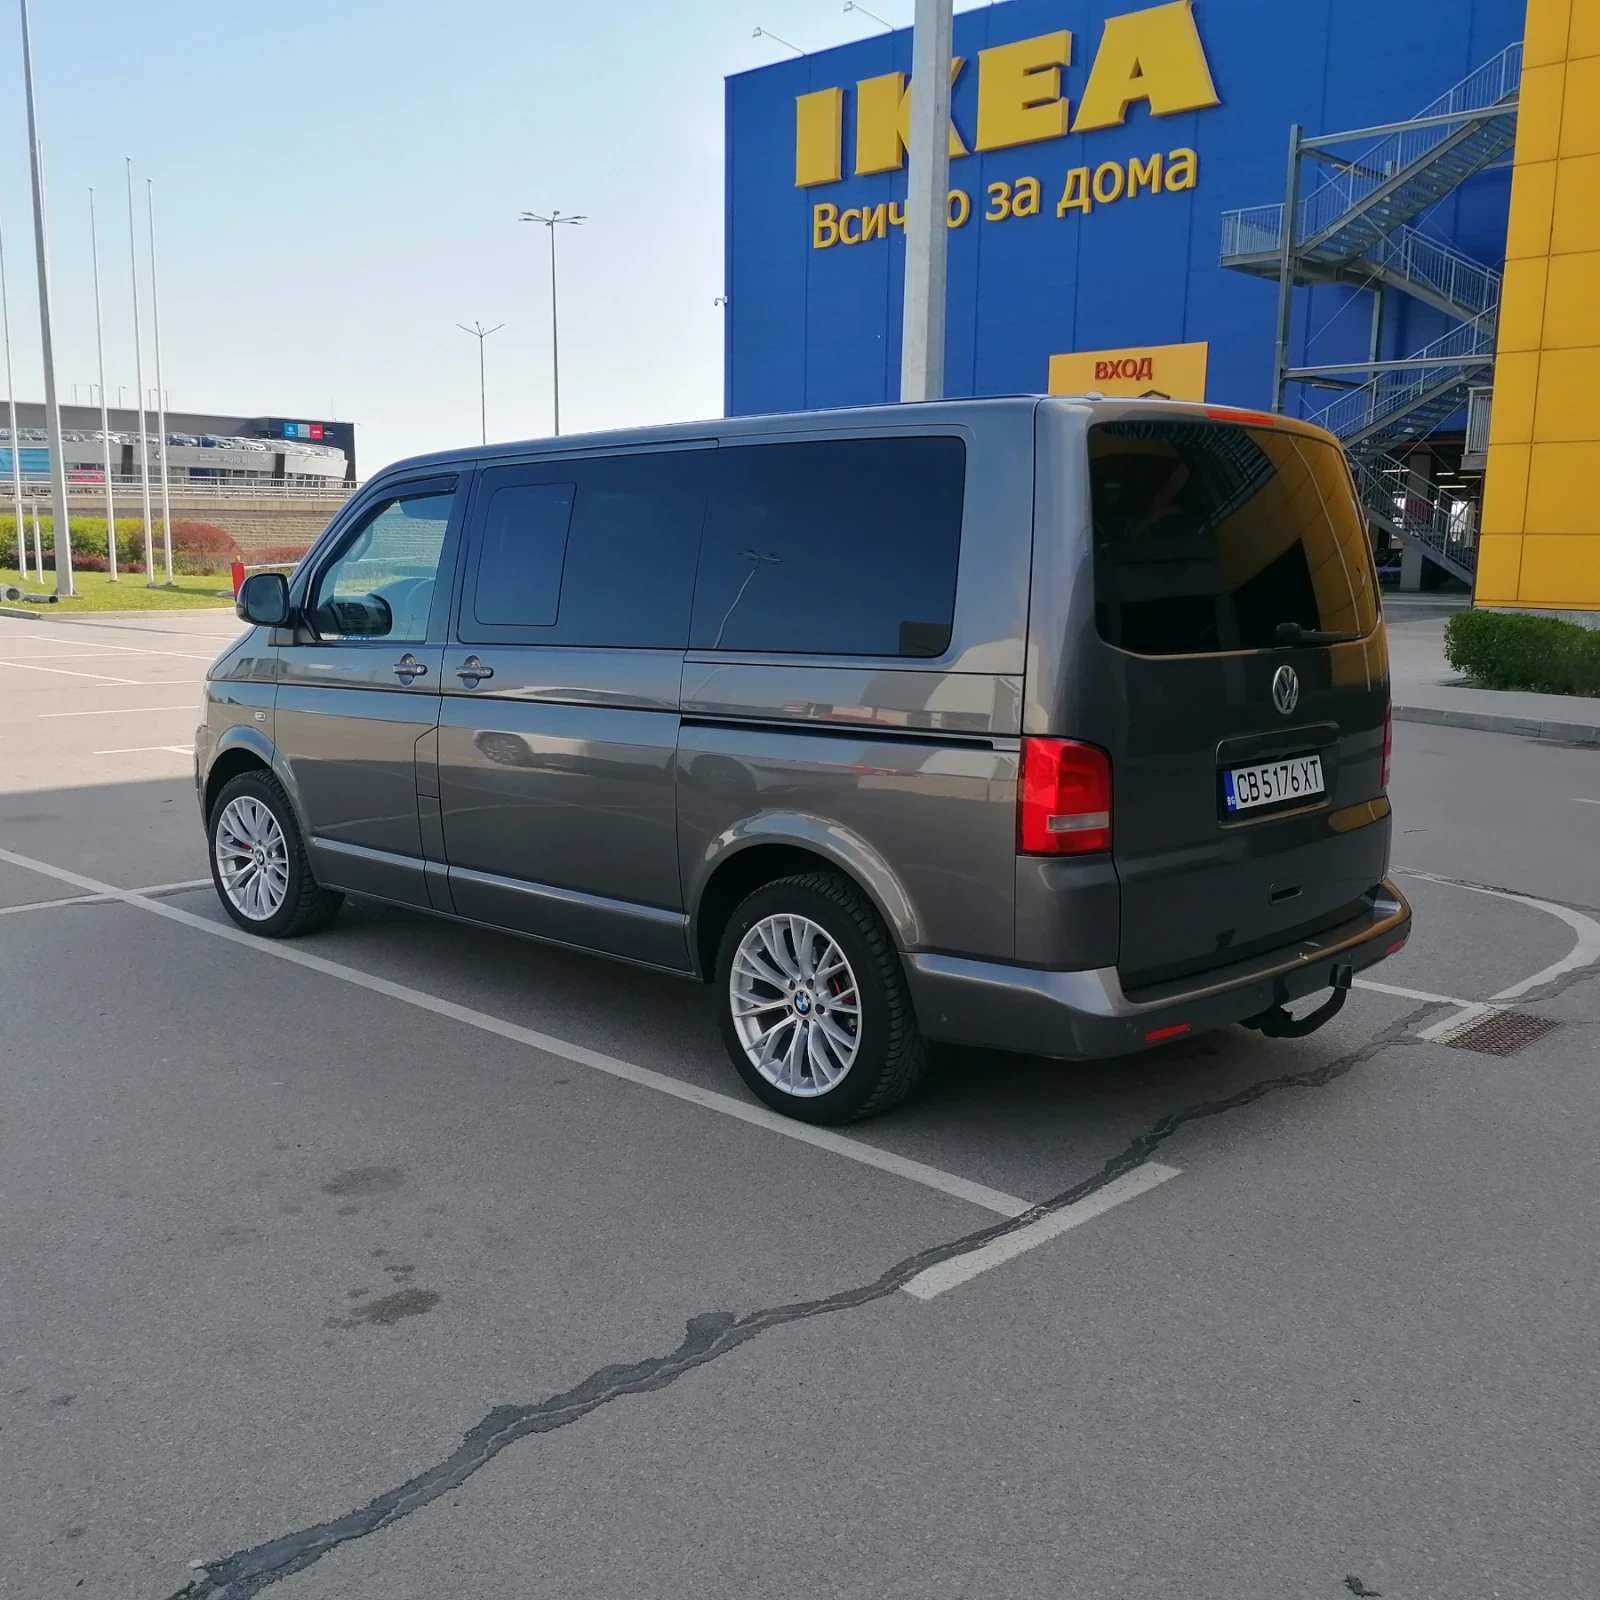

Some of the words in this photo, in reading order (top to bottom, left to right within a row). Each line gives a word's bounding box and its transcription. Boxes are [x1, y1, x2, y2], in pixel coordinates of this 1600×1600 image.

[795, 0, 1221, 188] IKEA
[813, 189, 970, 249] Всичо
[985, 176, 1040, 222] за
[1057, 147, 1198, 219] дома
[1095, 357, 1153, 381] ВХОД
